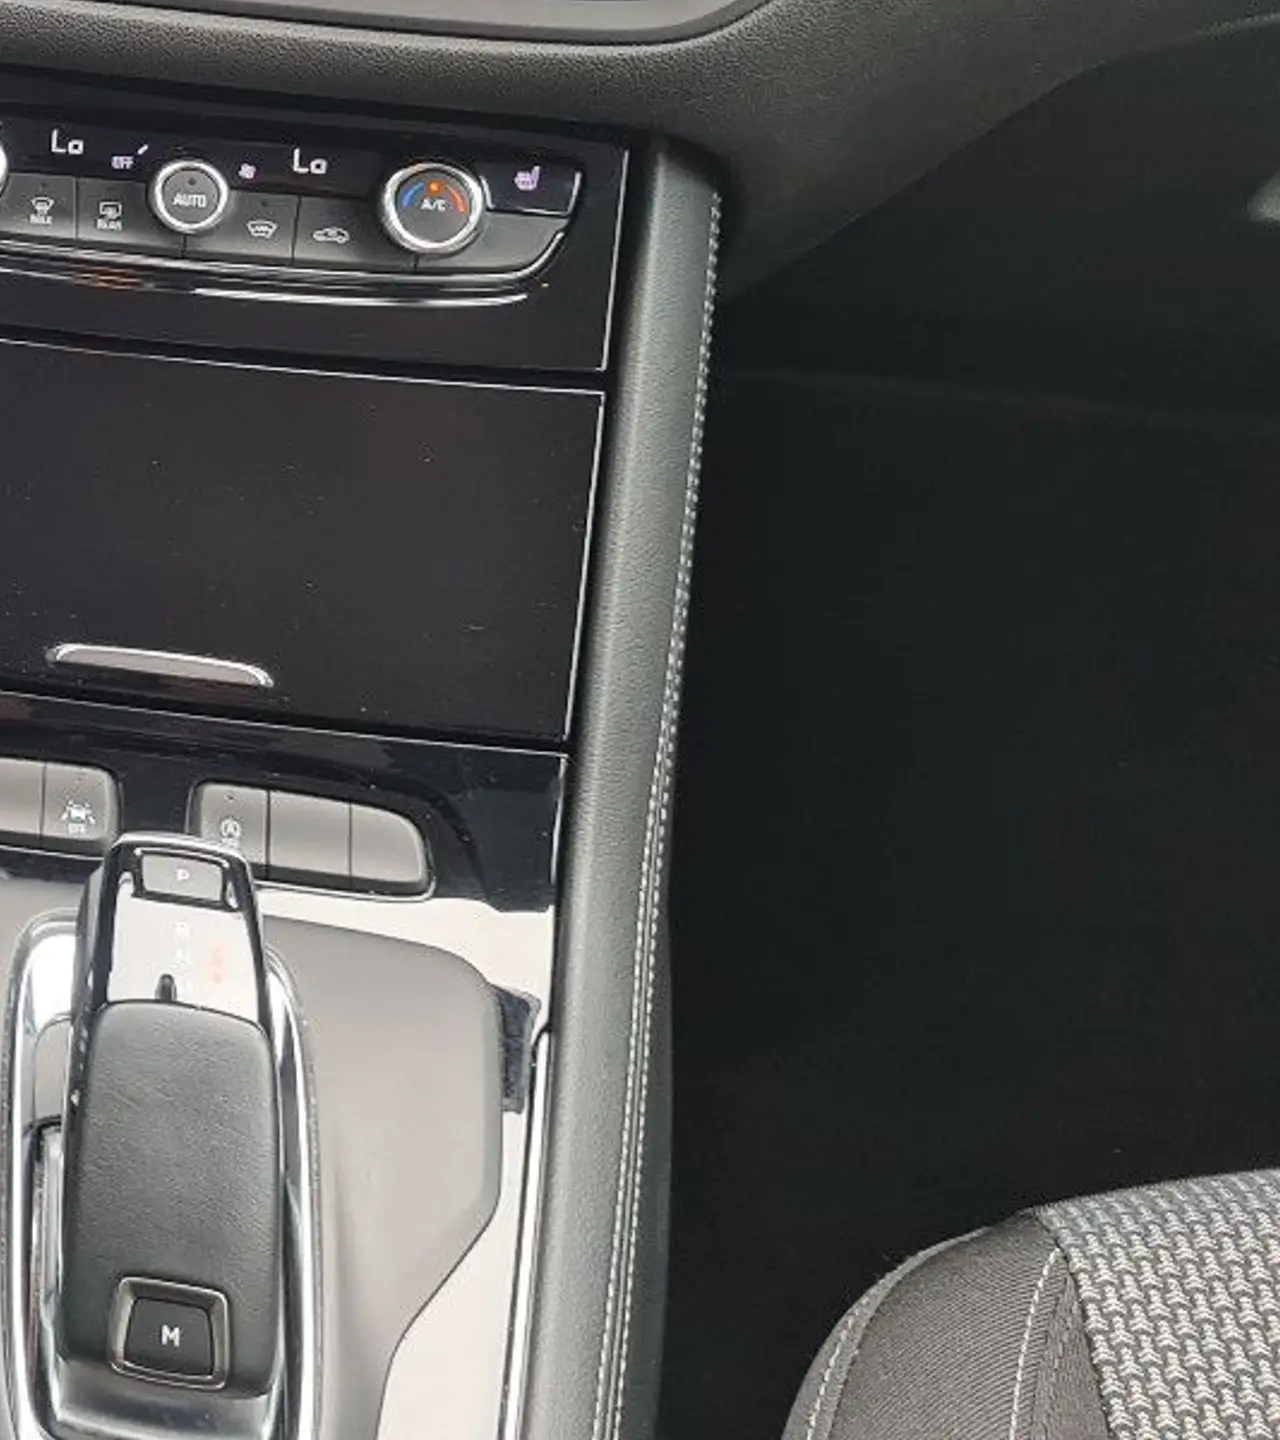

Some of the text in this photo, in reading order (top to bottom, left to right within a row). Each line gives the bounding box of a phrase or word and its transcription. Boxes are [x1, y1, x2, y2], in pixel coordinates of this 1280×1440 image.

[50, 128, 84, 155] Lo
[293, 148, 328, 175] Lo
[171, 192, 207, 209] AUTO
[420, 197, 448, 212] A/C
[176, 868, 190, 881] P
[161, 1324, 180, 1347] M
